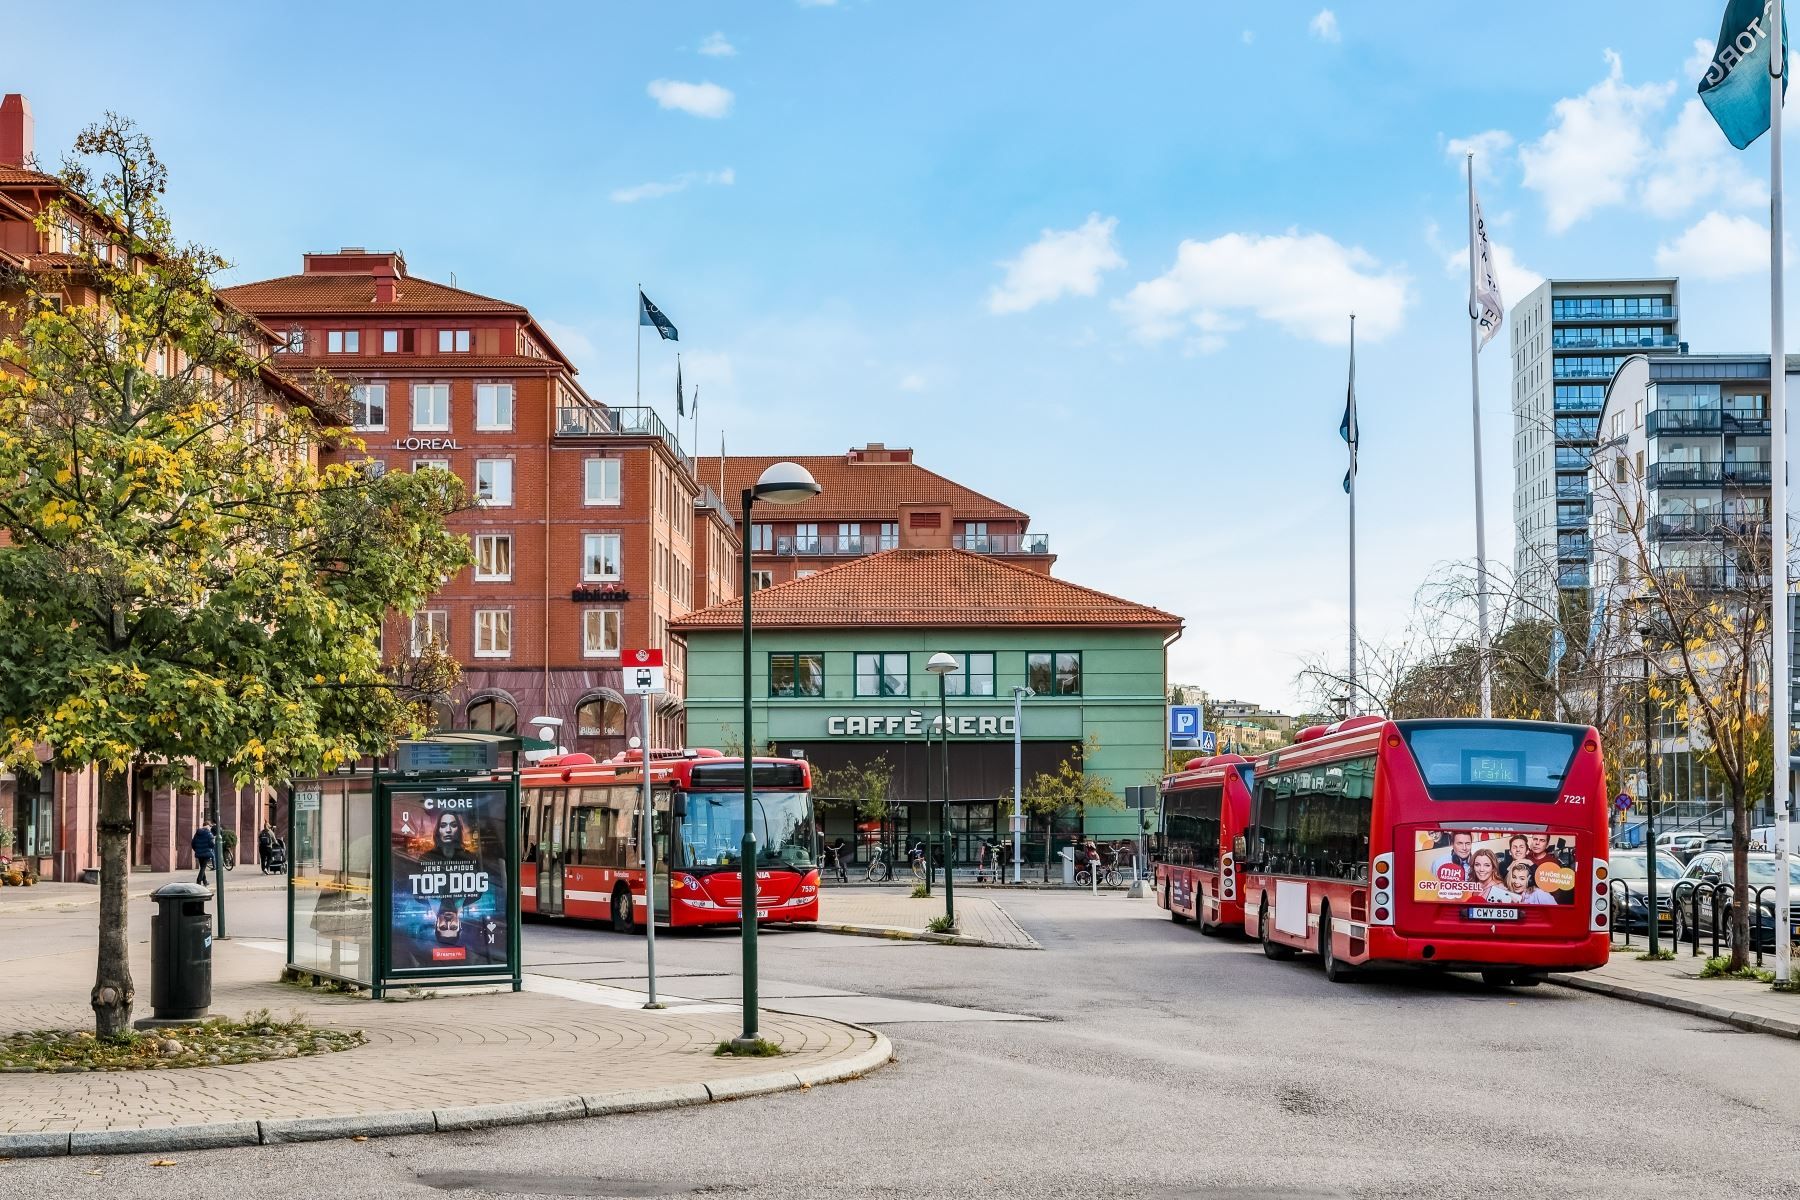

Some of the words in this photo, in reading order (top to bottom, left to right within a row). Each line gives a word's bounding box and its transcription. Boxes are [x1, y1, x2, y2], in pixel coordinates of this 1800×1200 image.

[828, 709, 922, 735] CAFFÈ
[1177, 713, 1194, 733] P
[437, 798, 473, 809] MORE
[1563, 794, 1586, 804] 7221
[736, 871, 771, 880] SNIA
[408, 873, 447, 895] TOP
[449, 871, 489, 893] DOG
[1419, 881, 1438, 890] GRY
[1440, 882, 1482, 892] FORSSELL
[801, 885, 816, 893] 7539
[1476, 908, 1494, 918] CWY
[1496, 909, 1515, 919] 850
